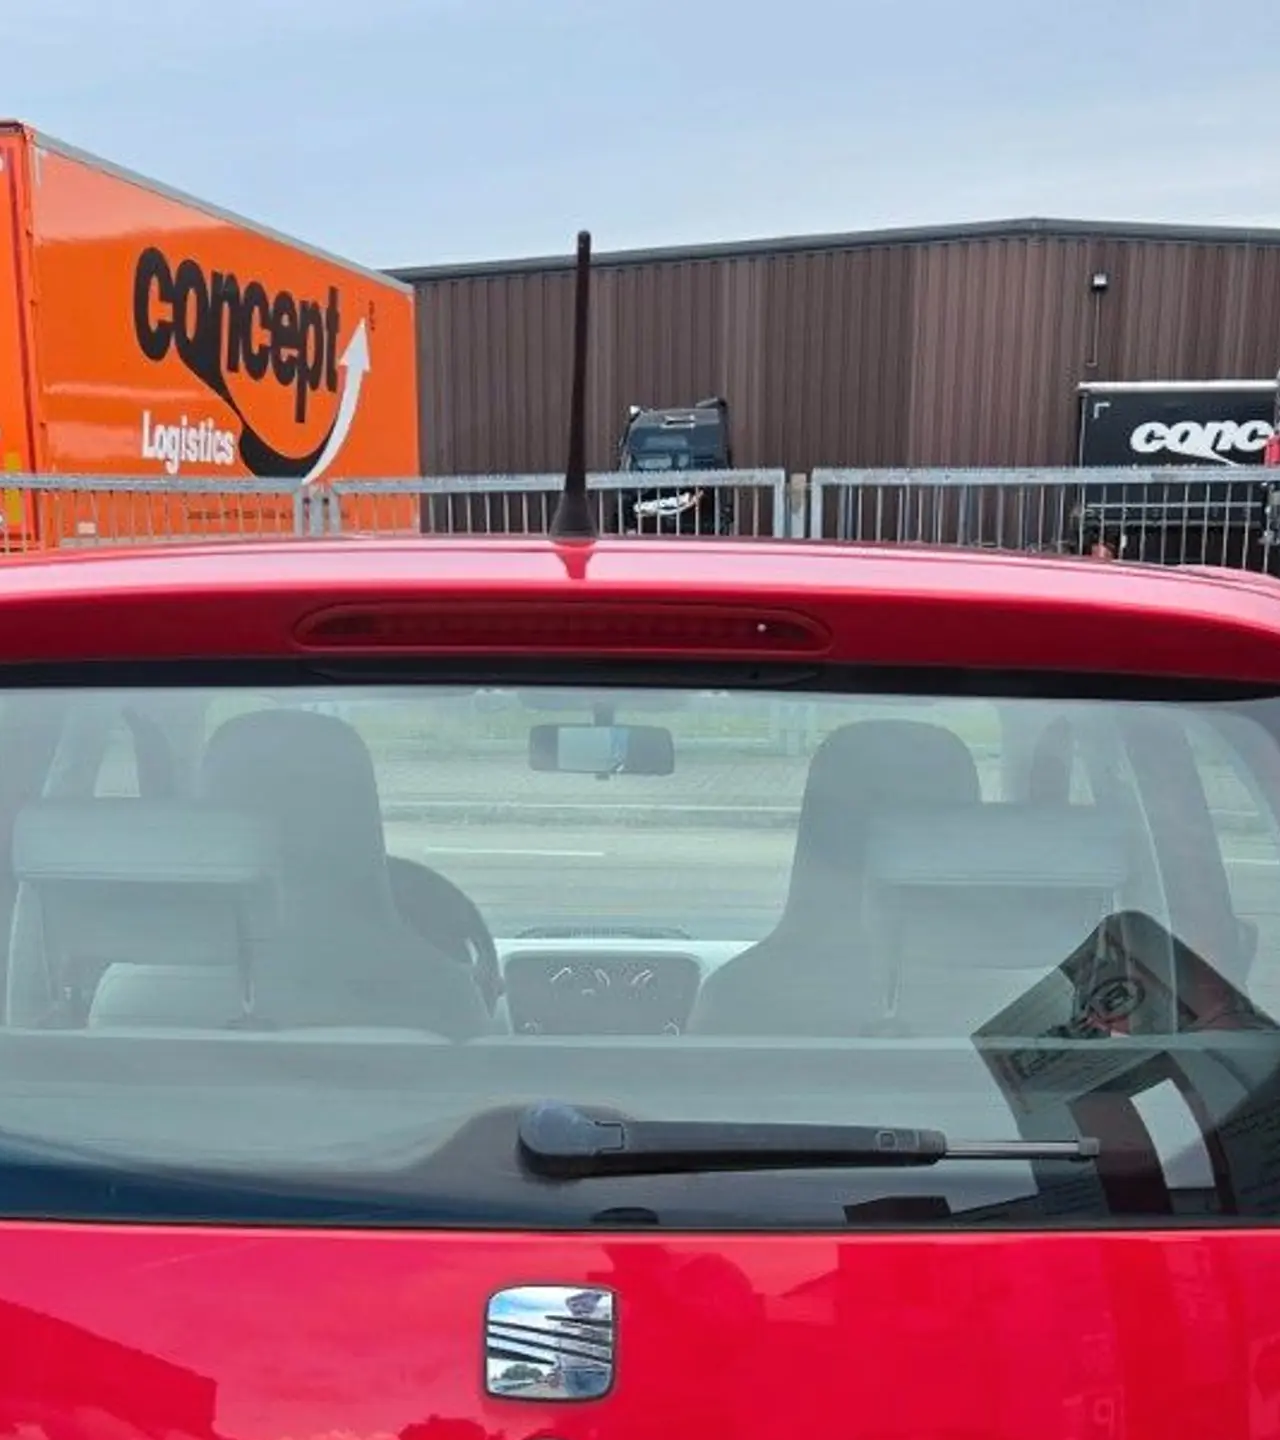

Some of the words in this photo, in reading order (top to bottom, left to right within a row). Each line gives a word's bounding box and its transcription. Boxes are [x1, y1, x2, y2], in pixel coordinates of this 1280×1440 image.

[134, 247, 340, 423] concept
[142, 411, 235, 474] Logistics
[1130, 420, 1274, 452] conc
